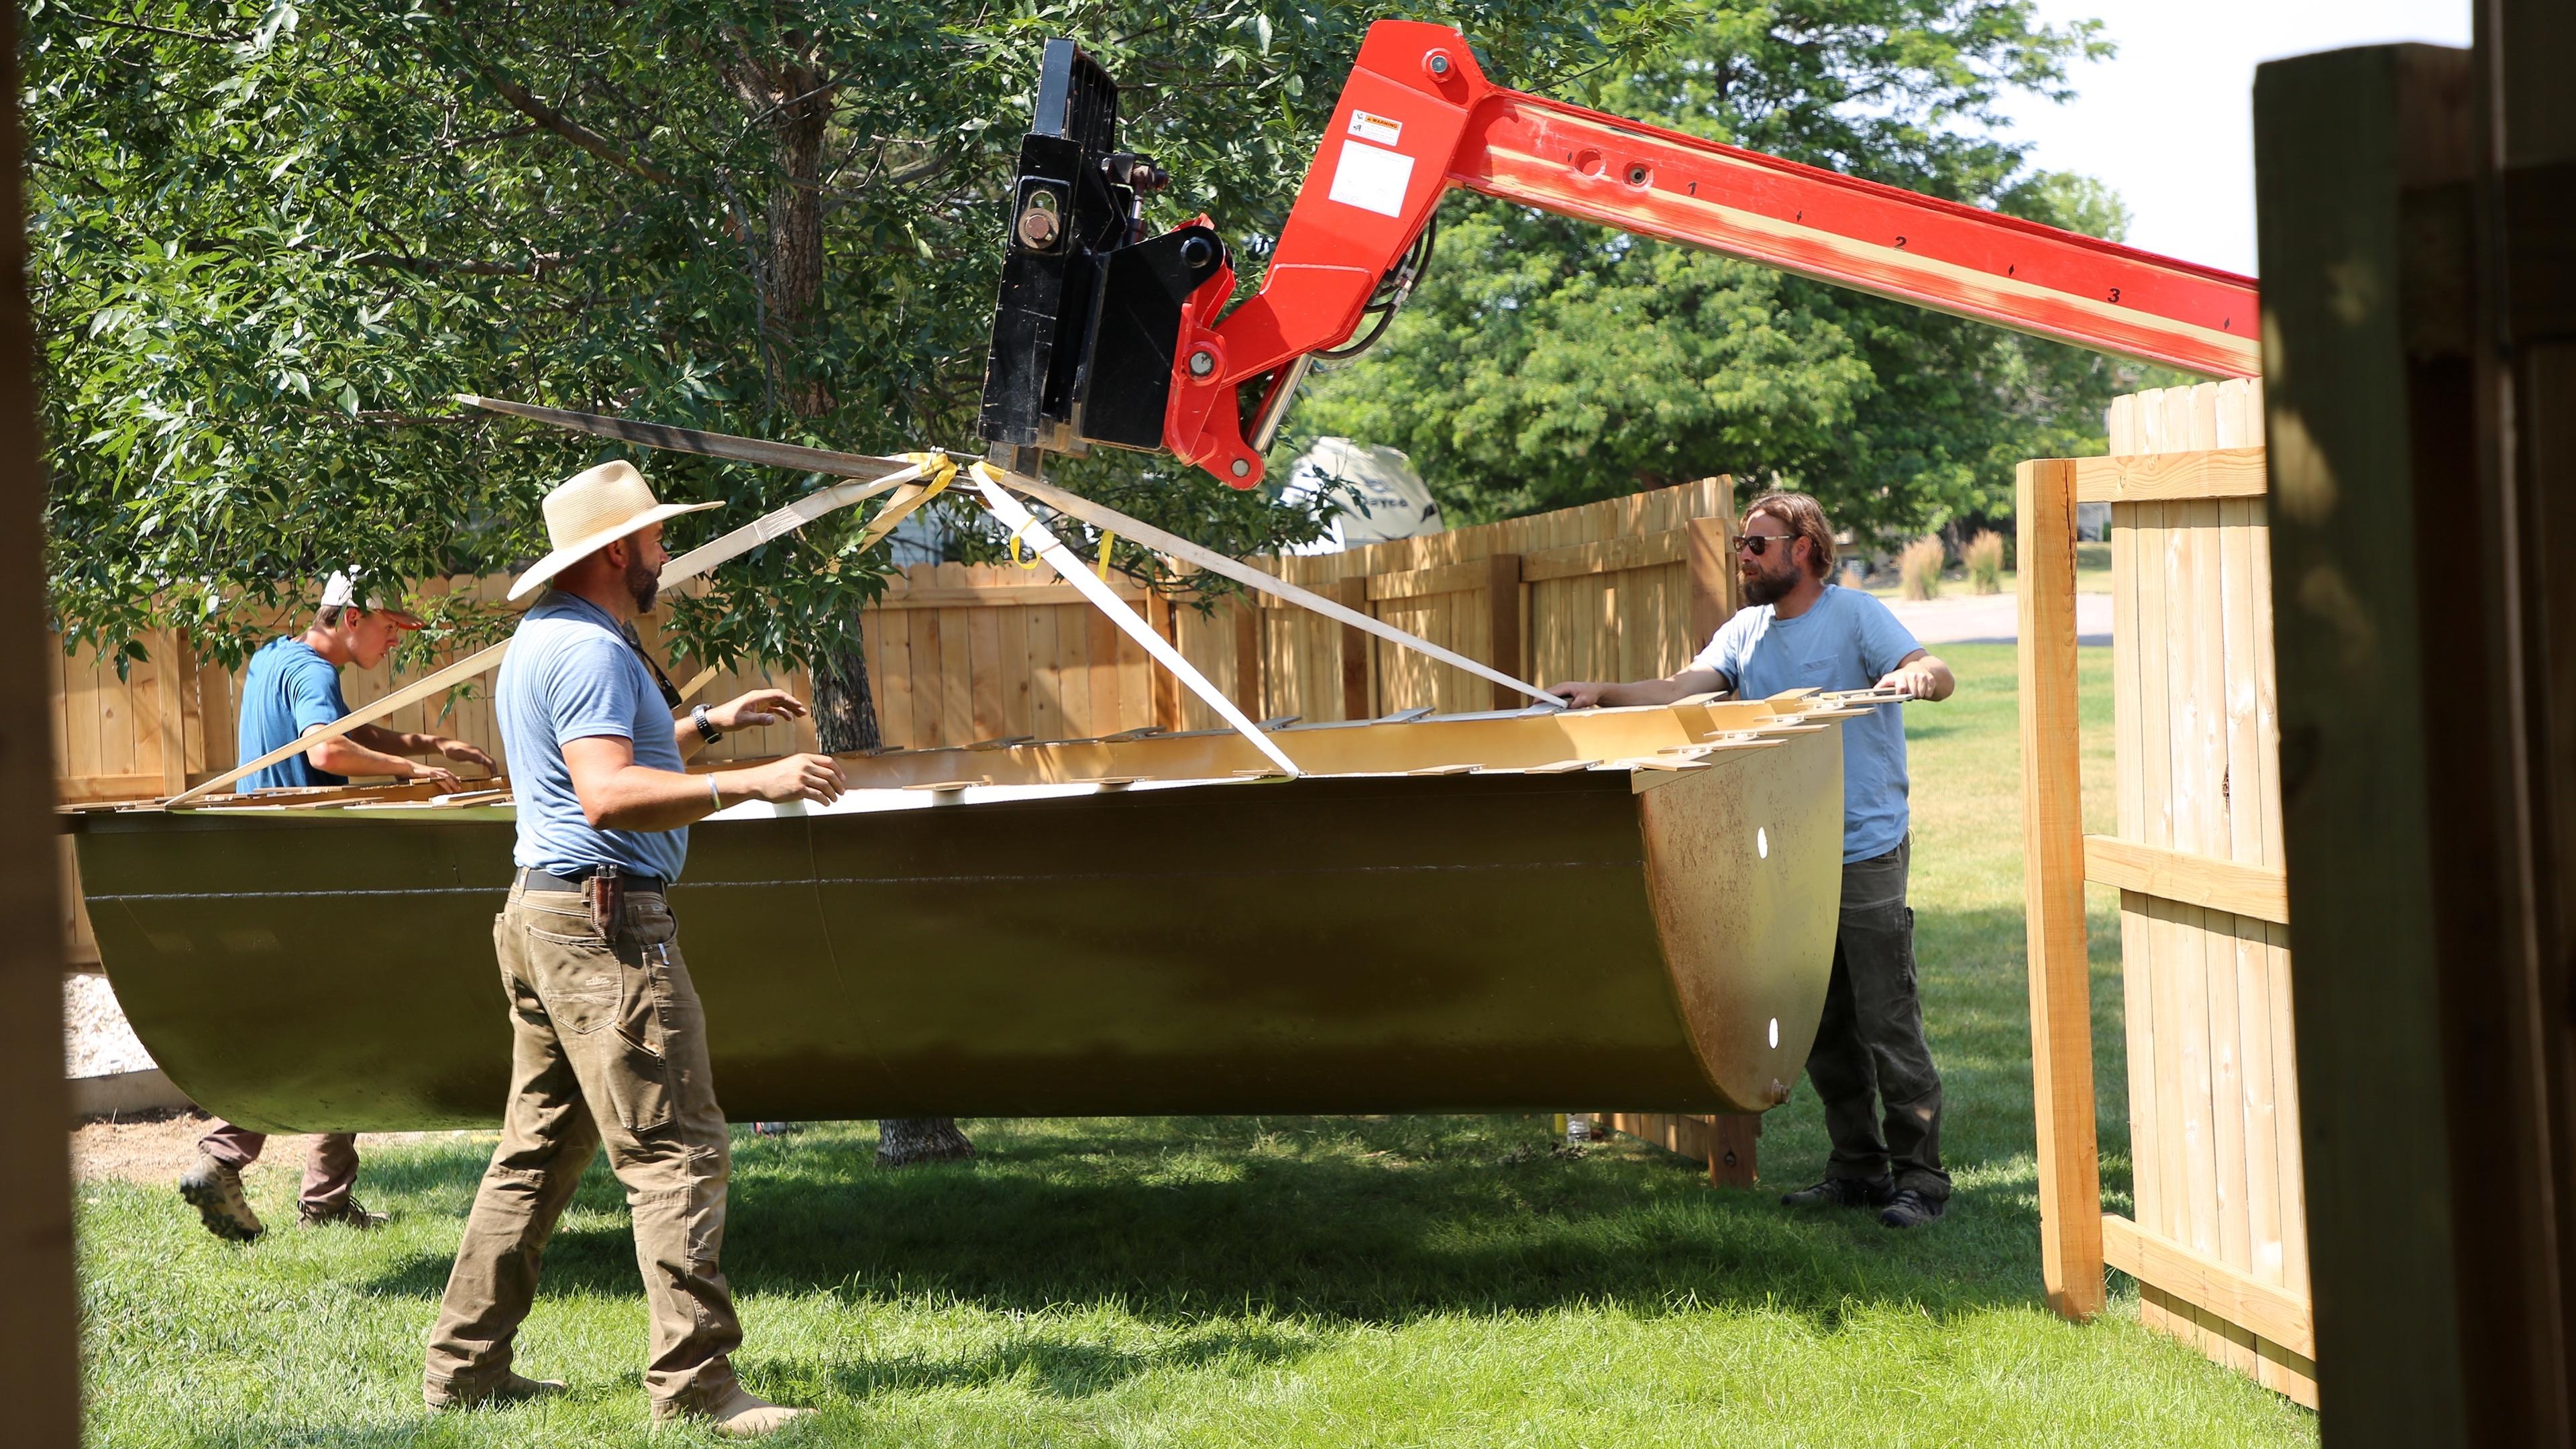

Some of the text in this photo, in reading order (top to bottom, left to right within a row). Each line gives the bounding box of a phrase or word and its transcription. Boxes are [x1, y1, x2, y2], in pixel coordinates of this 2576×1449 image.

[1373, 118, 1398, 129] WARNING
[1688, 181, 1697, 195] 1
[1894, 236, 1907, 251] 2
[2107, 288, 2121, 303] 3
